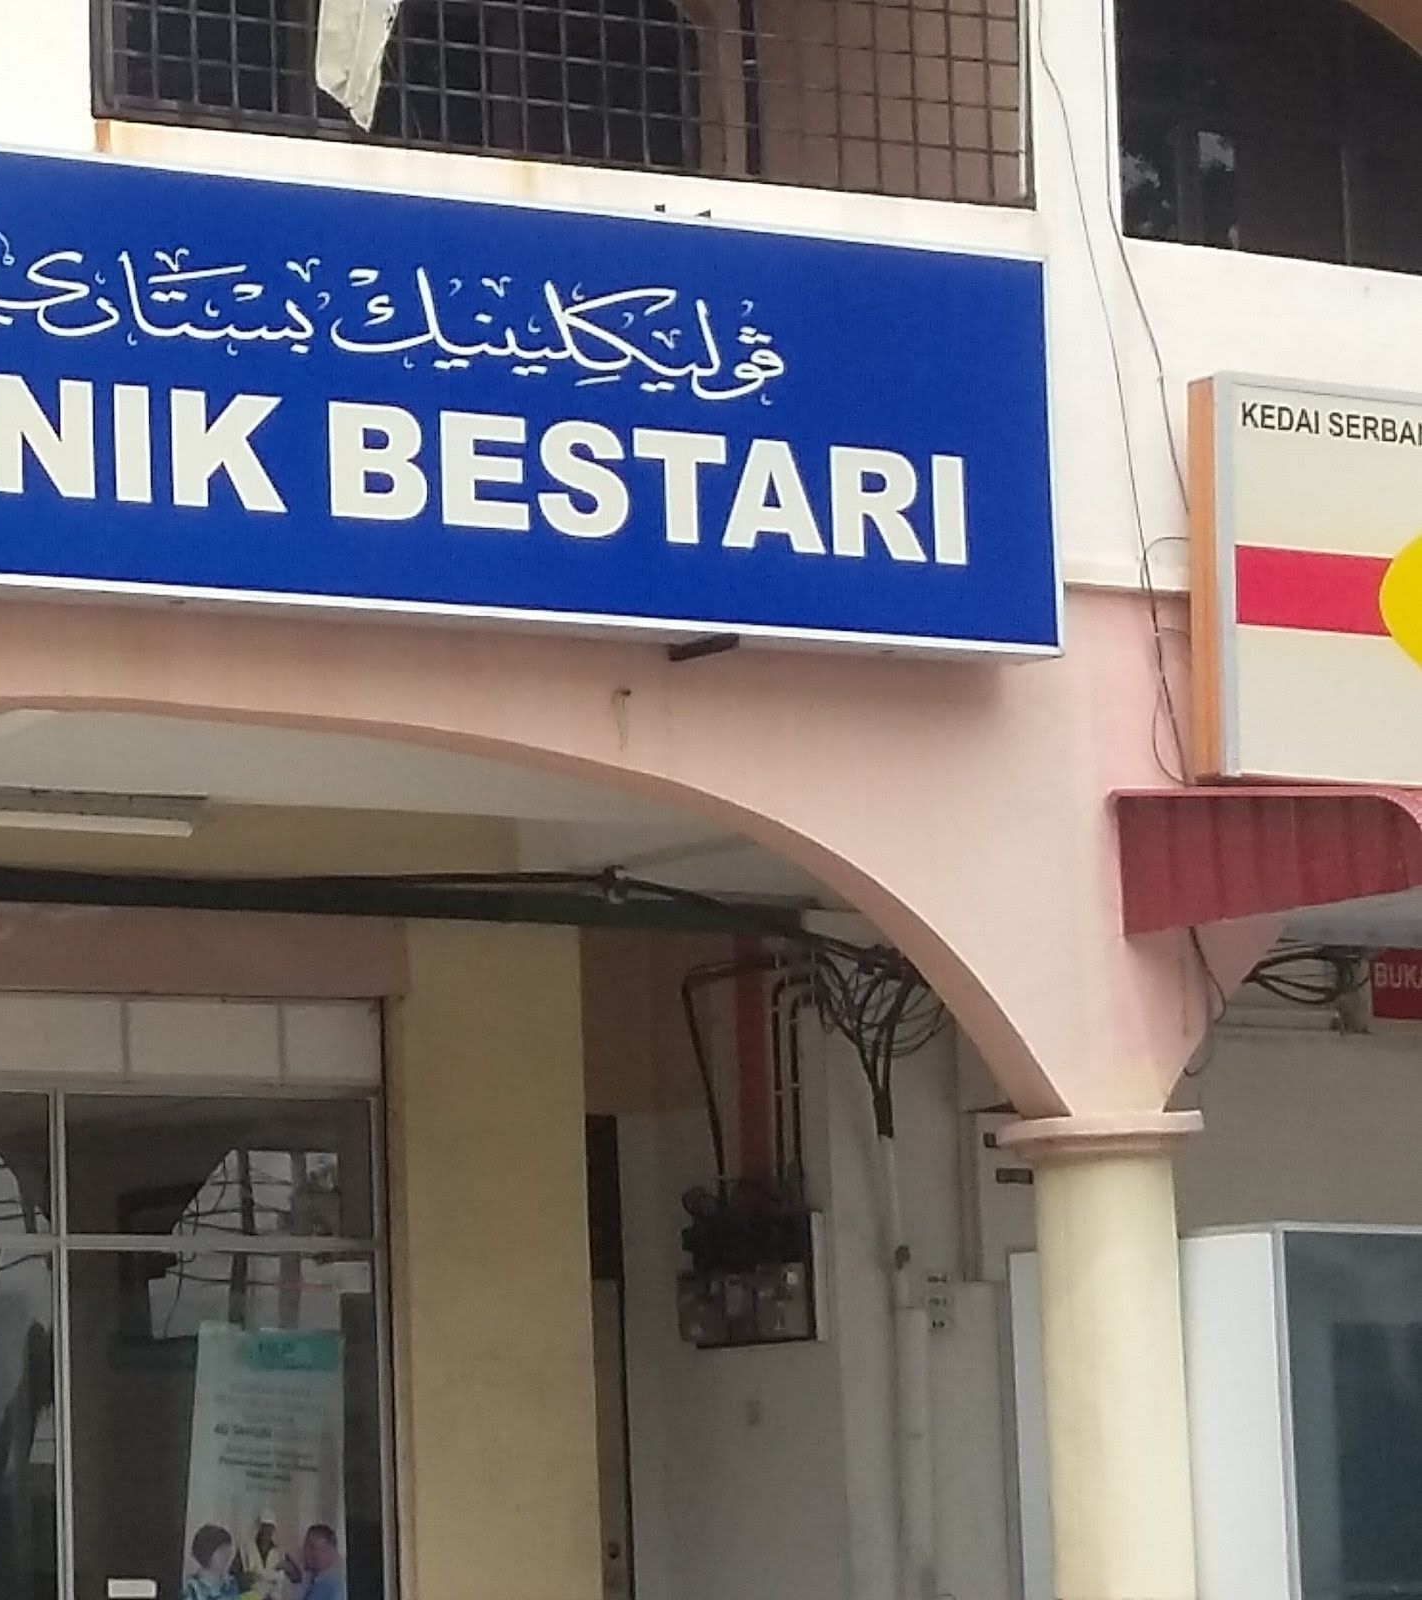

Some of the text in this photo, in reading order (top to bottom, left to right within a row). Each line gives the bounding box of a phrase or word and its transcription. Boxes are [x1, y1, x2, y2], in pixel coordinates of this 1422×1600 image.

[1241, 402, 1422, 447] KEDAI SERBA
[328, 401, 969, 566] BESTARI
[1375, 962, 1422, 989] BUK
